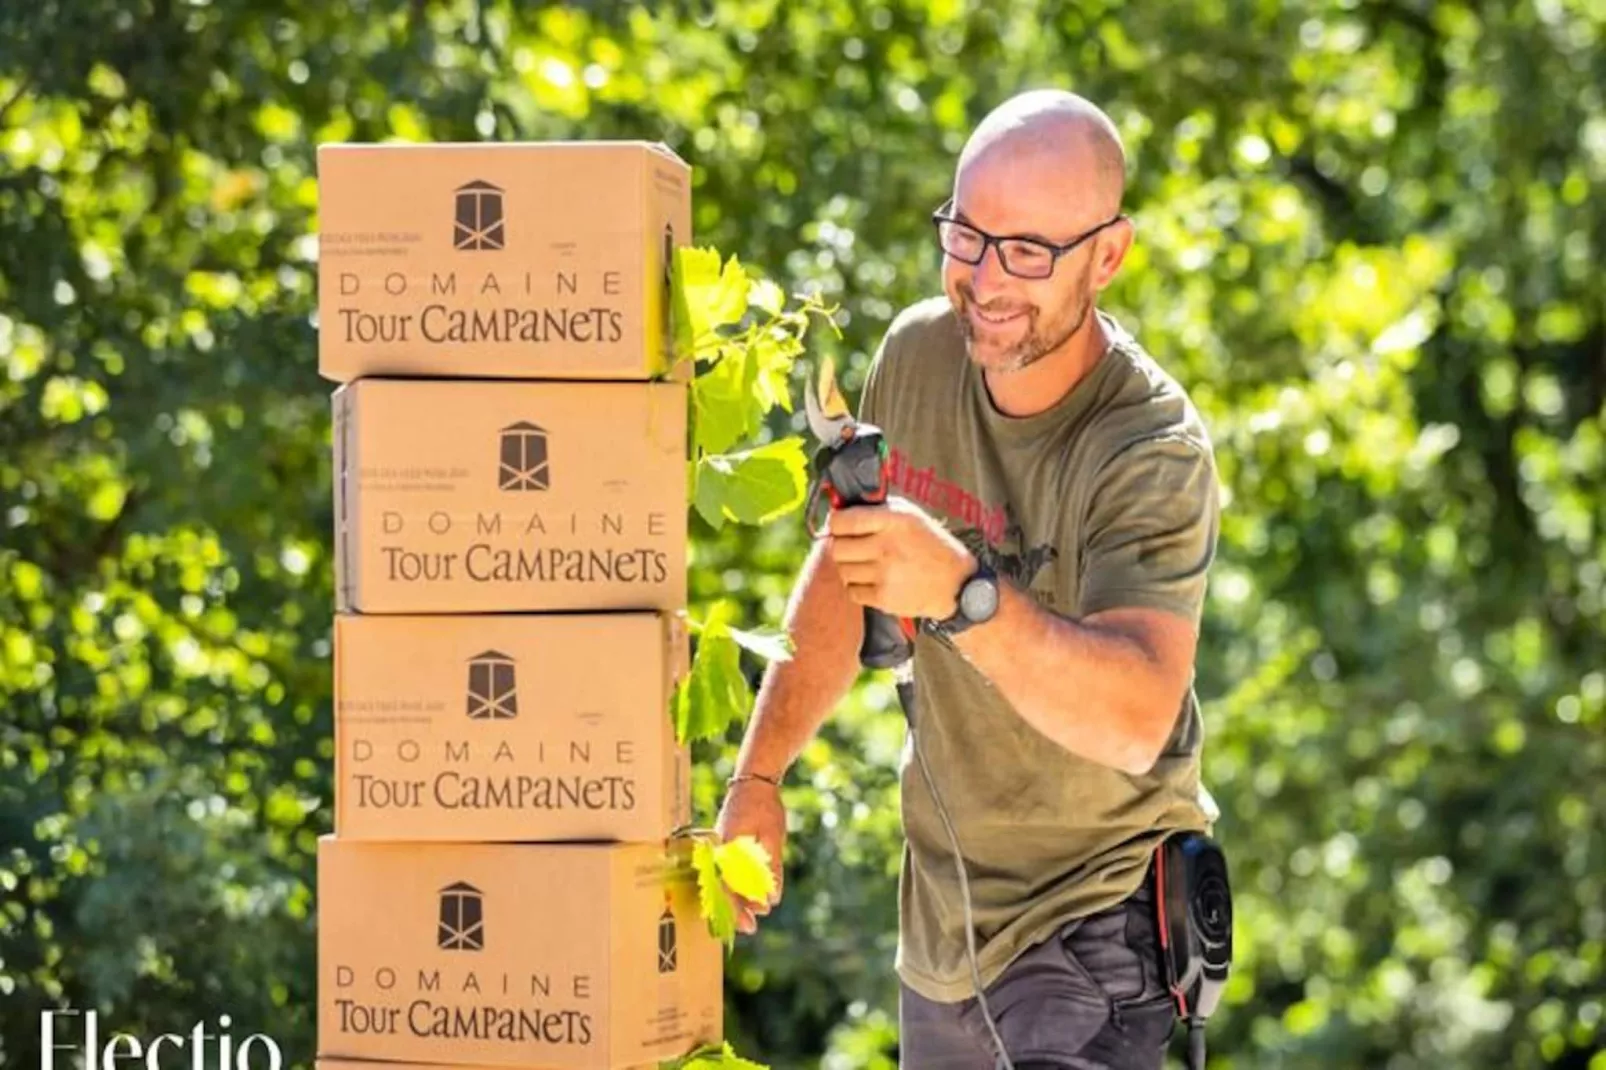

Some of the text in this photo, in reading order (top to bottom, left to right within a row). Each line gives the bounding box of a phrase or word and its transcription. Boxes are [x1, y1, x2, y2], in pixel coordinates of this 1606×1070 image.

[339, 271, 621, 295] DOMAINE
[338, 307, 413, 343] Tour
[382, 511, 666, 535] DOMAINE
[381, 546, 458, 581] Tour
[352, 740, 634, 763] DOMAINE
[352, 773, 426, 808] Tour
[336, 965, 590, 998] DOMAINE
[334, 999, 401, 1034] Tour
